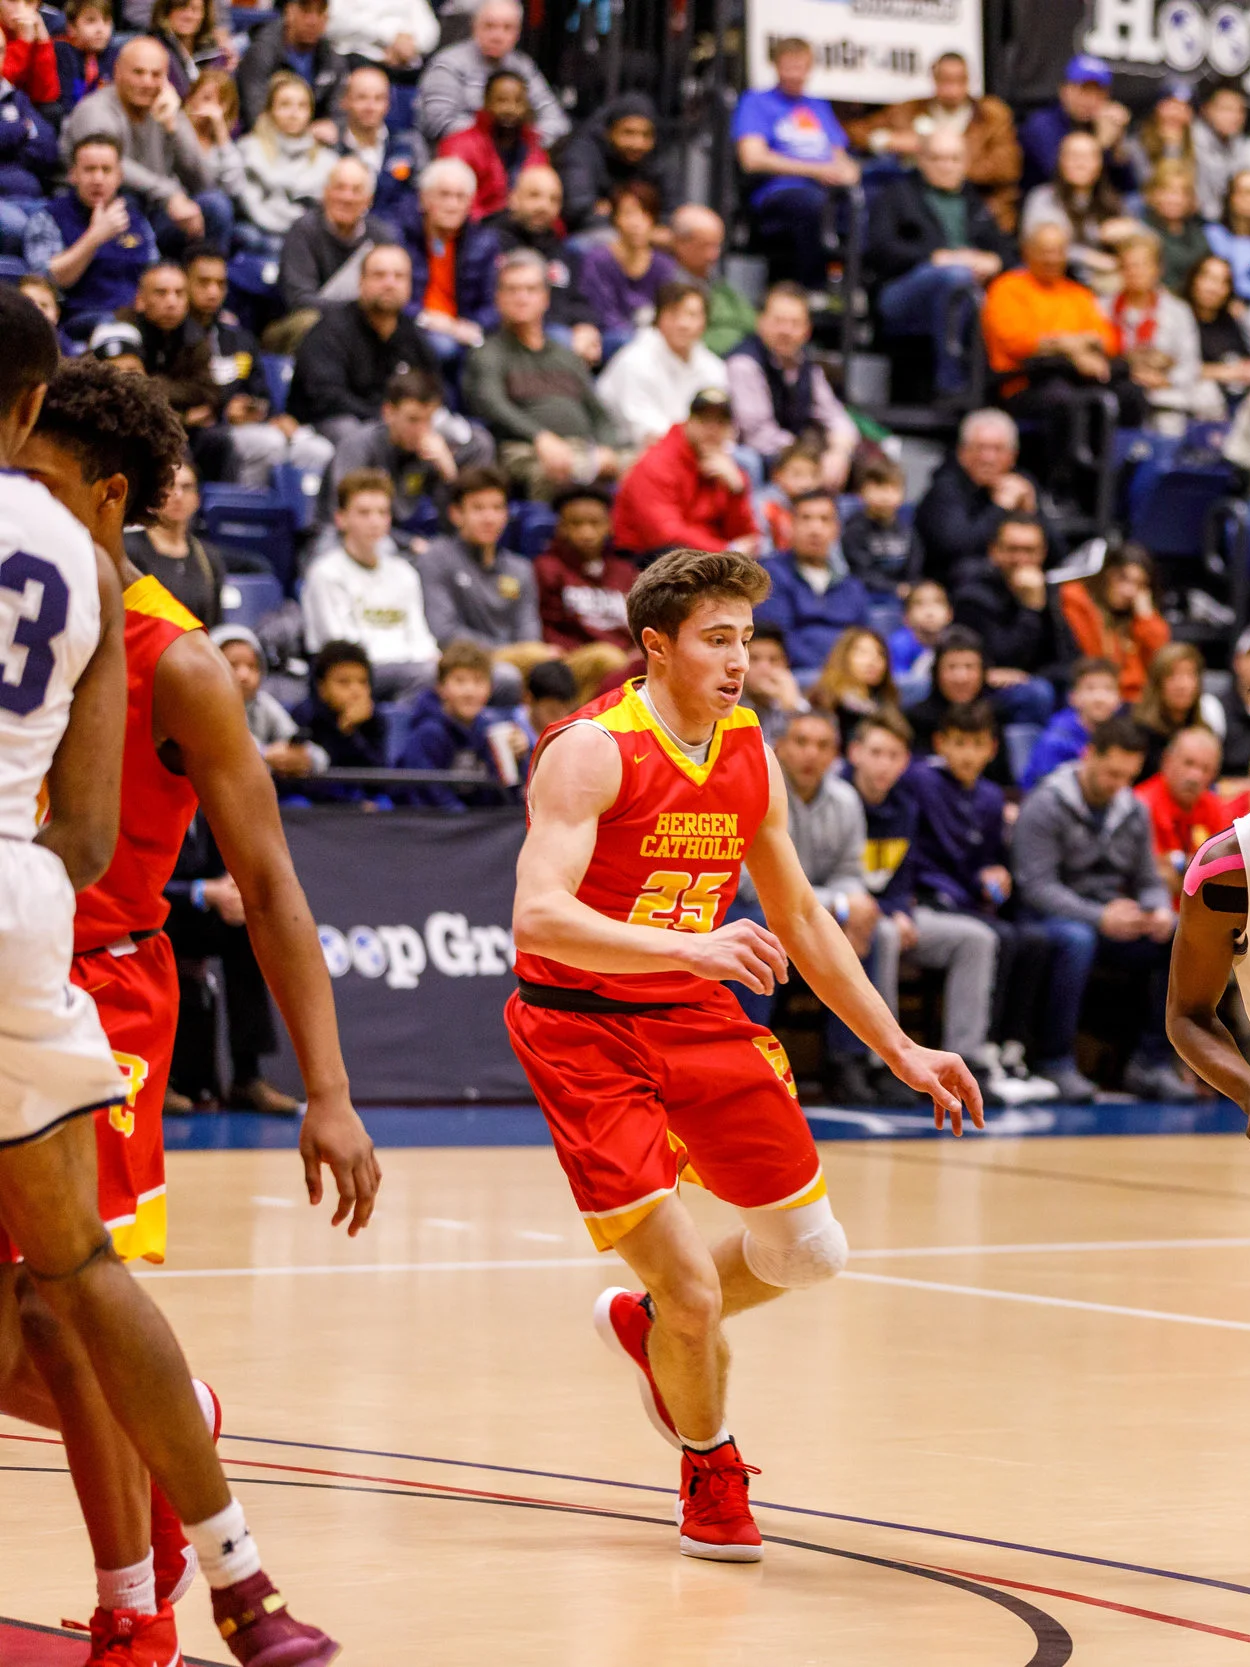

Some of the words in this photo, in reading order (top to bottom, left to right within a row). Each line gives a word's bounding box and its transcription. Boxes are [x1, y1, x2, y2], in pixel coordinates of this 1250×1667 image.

[654, 812, 739, 837] BERGEN
[639, 835, 745, 860] CATHOLIC
[626, 870, 733, 934] 25
